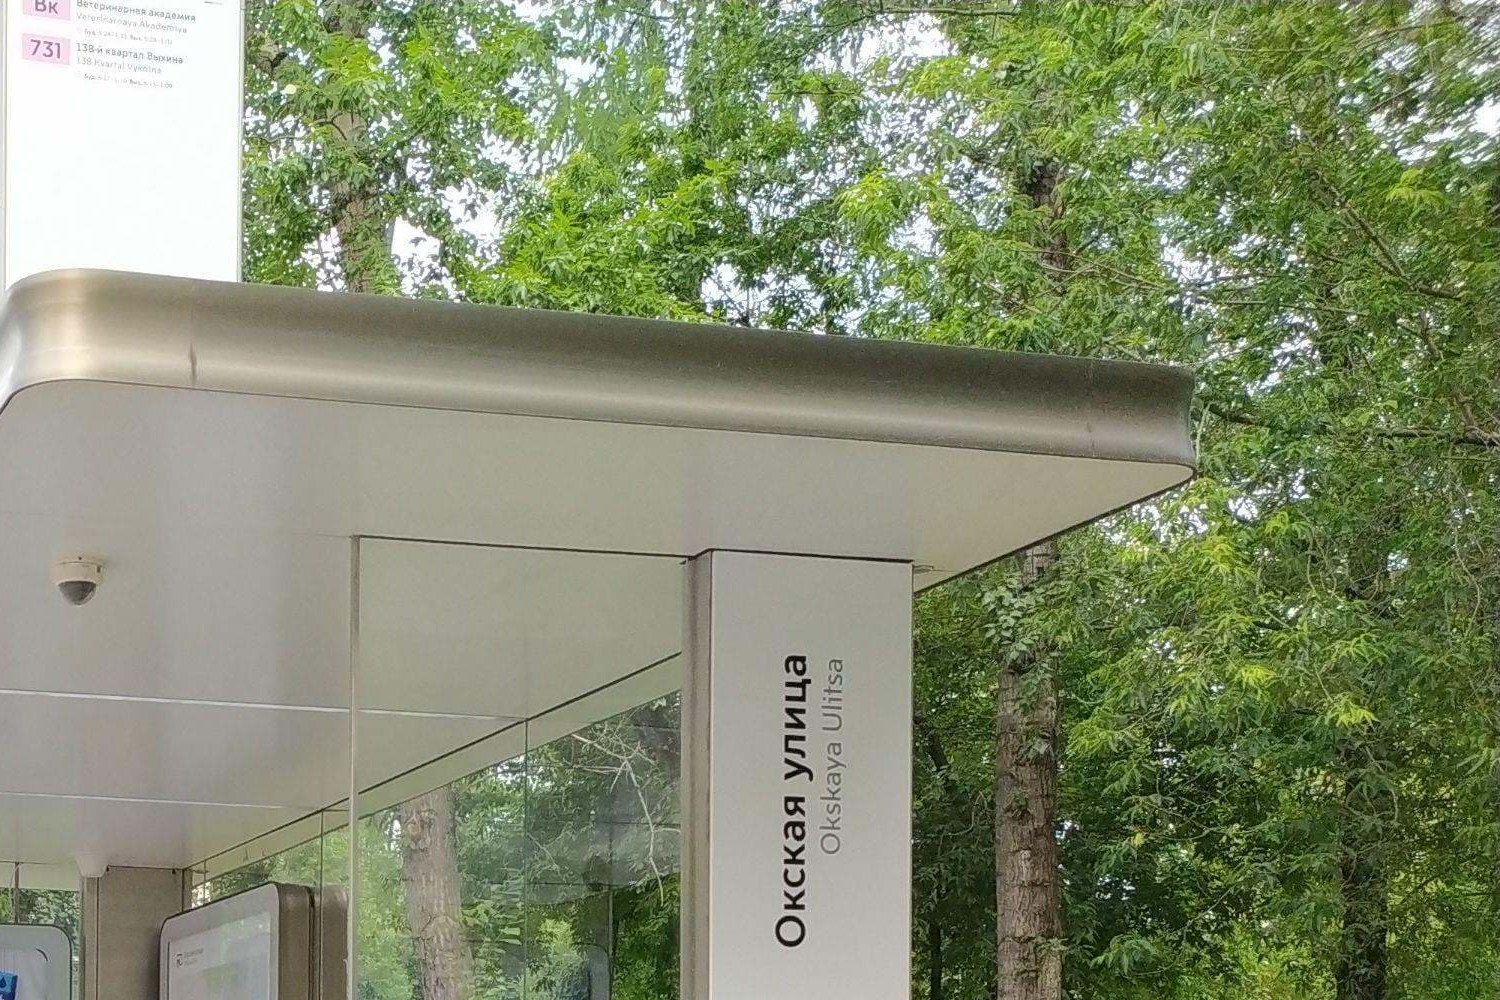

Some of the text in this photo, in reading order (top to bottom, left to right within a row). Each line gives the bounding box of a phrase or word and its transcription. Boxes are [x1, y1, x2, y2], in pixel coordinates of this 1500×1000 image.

[34, 0, 59, 14] Вк
[149, 9, 196, 22] академия
[30, 39, 61, 59] 731
[76, 42, 184, 64] 138-й квартал Выхина
[76, 57, 92, 66] 138
[820, 658, 847, 856] Okskaya Ulitsa
[774, 654, 814, 948] Окская улица
